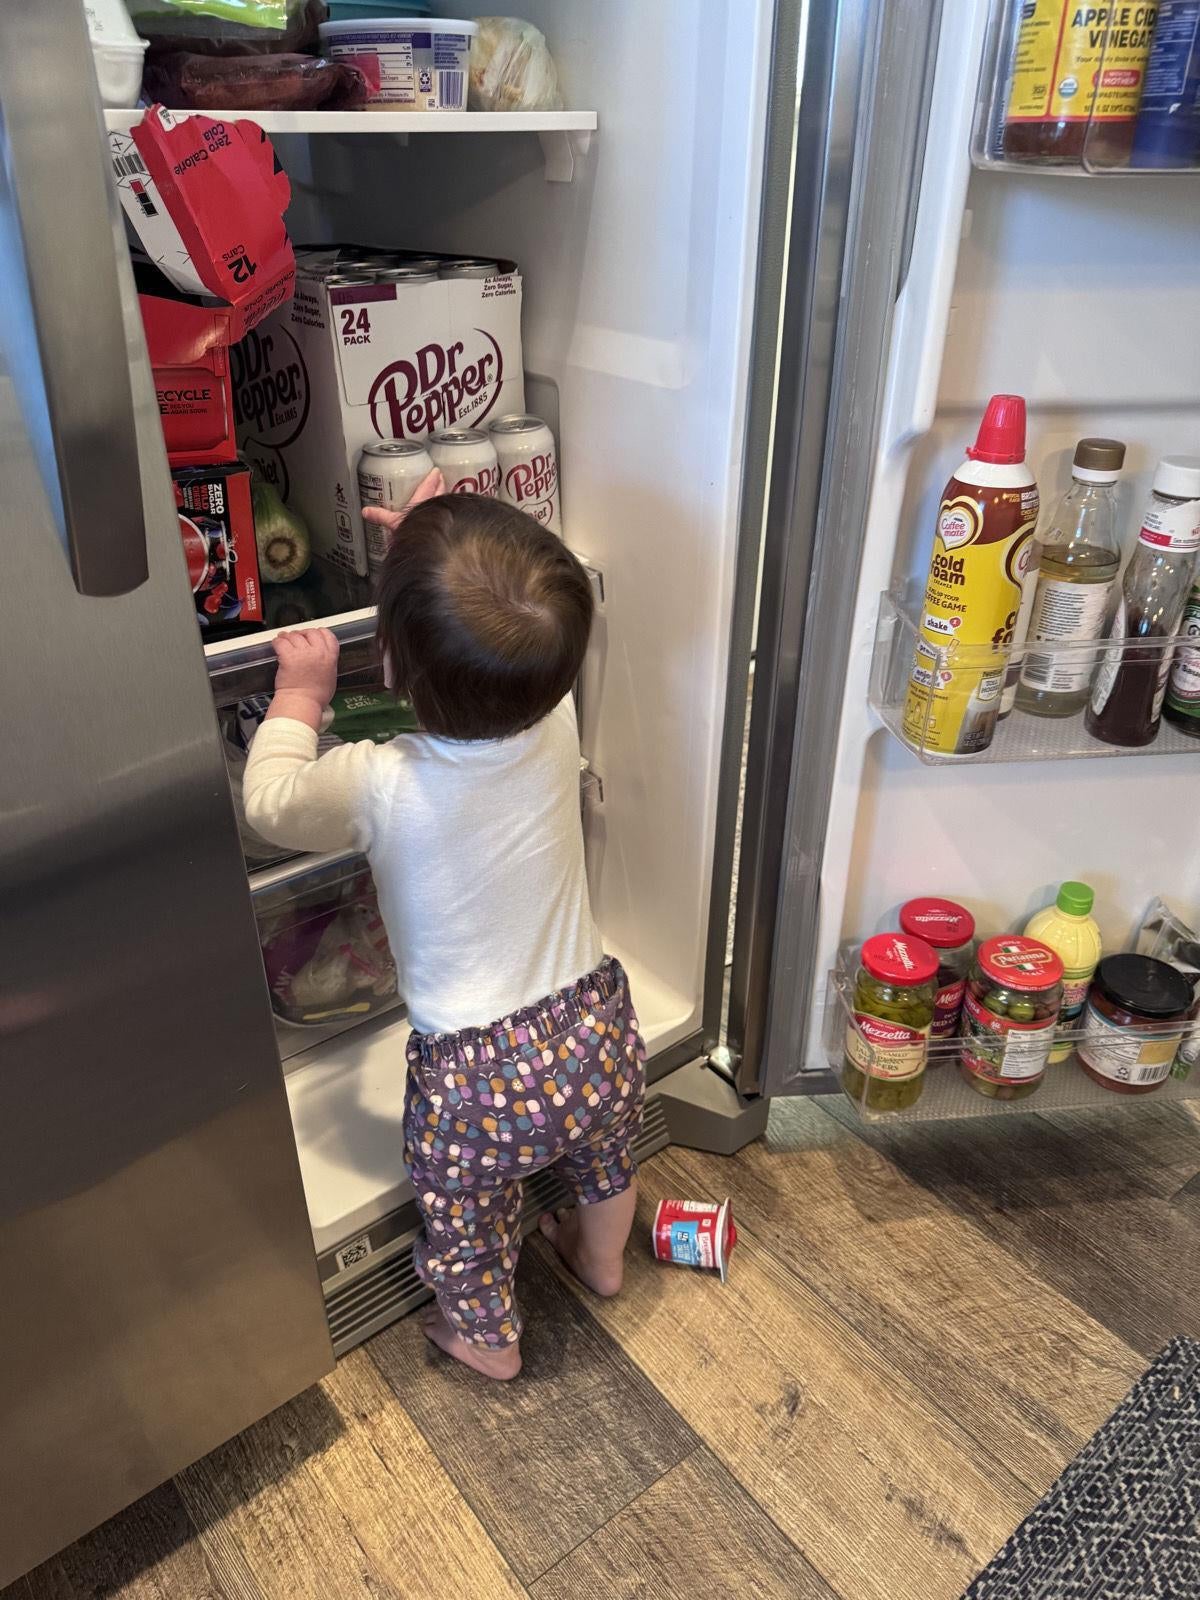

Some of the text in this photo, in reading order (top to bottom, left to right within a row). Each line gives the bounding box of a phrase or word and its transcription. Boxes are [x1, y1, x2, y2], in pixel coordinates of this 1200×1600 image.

[1071, 7, 1157, 28] APPLE CID
[203, 123, 225, 141] Cola
[174, 134, 232, 175] Zero Calorie
[222, 244, 245, 262] Cans
[227, 254, 257, 283] 12
[483, 283, 497, 291] Zero
[495, 289, 516, 298] Calories
[340, 308, 371, 335] 24
[343, 335, 371, 346] PACK
[415, 341, 464, 395] Dr
[156, 389, 211, 402] ECYCLE
[368, 353, 494, 439] Pepper
[530, 453, 551, 482] Dr
[478, 465, 497, 491] Dr
[505, 463, 558, 502] Peppe
[207, 484, 215, 514] SUGAR
[213, 483, 224, 514] ZERO
[941, 517, 966, 531] Coffee
[935, 553, 965, 573] cold
[930, 561, 966, 586] foam
[941, 599, 967, 613] GAME
[944, 592, 960, 603] YOUR
[927, 618, 949, 631] shake
[913, 915, 962, 923] Mezzetta
[860, 1020, 911, 1040] Mezzetta
